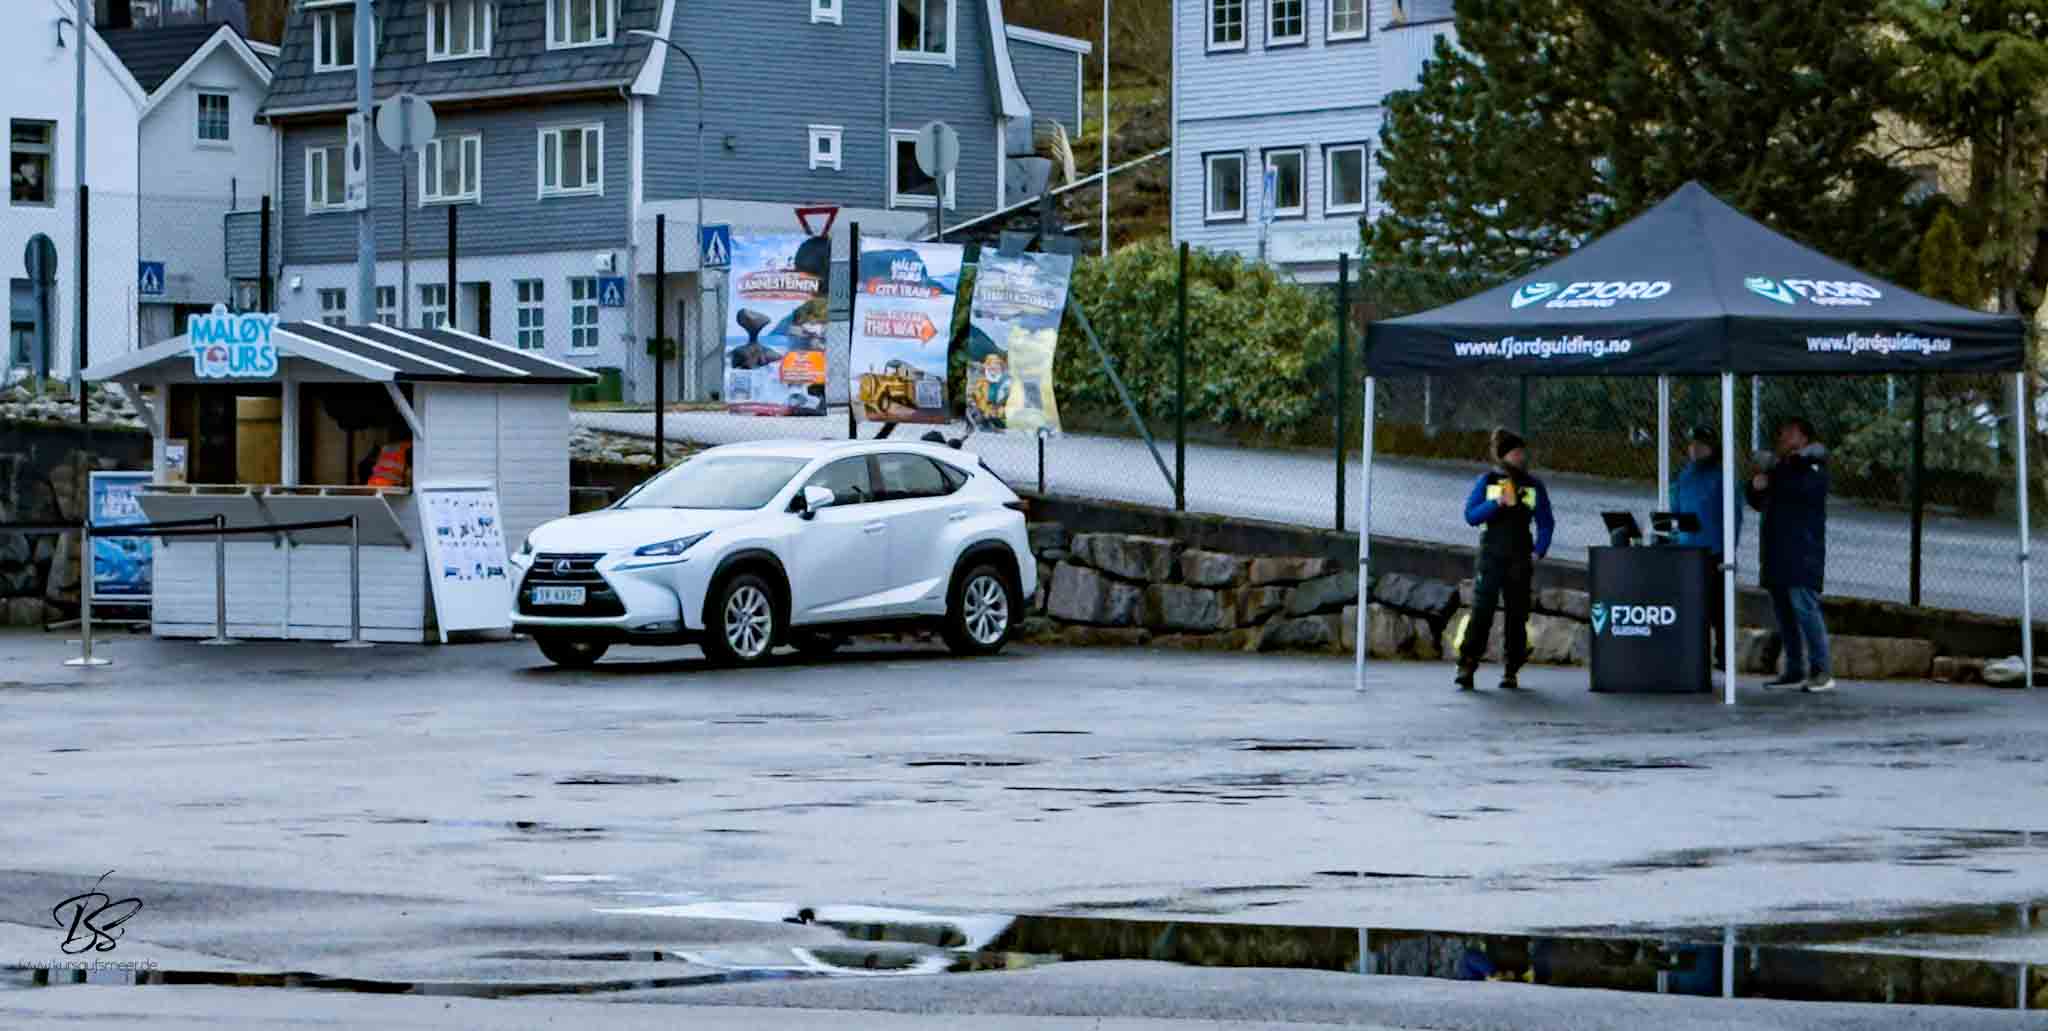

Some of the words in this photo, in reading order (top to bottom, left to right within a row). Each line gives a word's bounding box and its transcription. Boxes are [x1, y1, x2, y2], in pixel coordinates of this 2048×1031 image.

[1556, 279, 1672, 299] FJORD
[191, 306, 276, 345] MÅLØY
[865, 319, 894, 336] THIS
[1454, 336, 1631, 359] www.fjordguiding.no
[1806, 332, 1951, 355] www.fjordguiding.no
[194, 344, 275, 372] TOURS
[1611, 605, 1677, 625] FJORD
